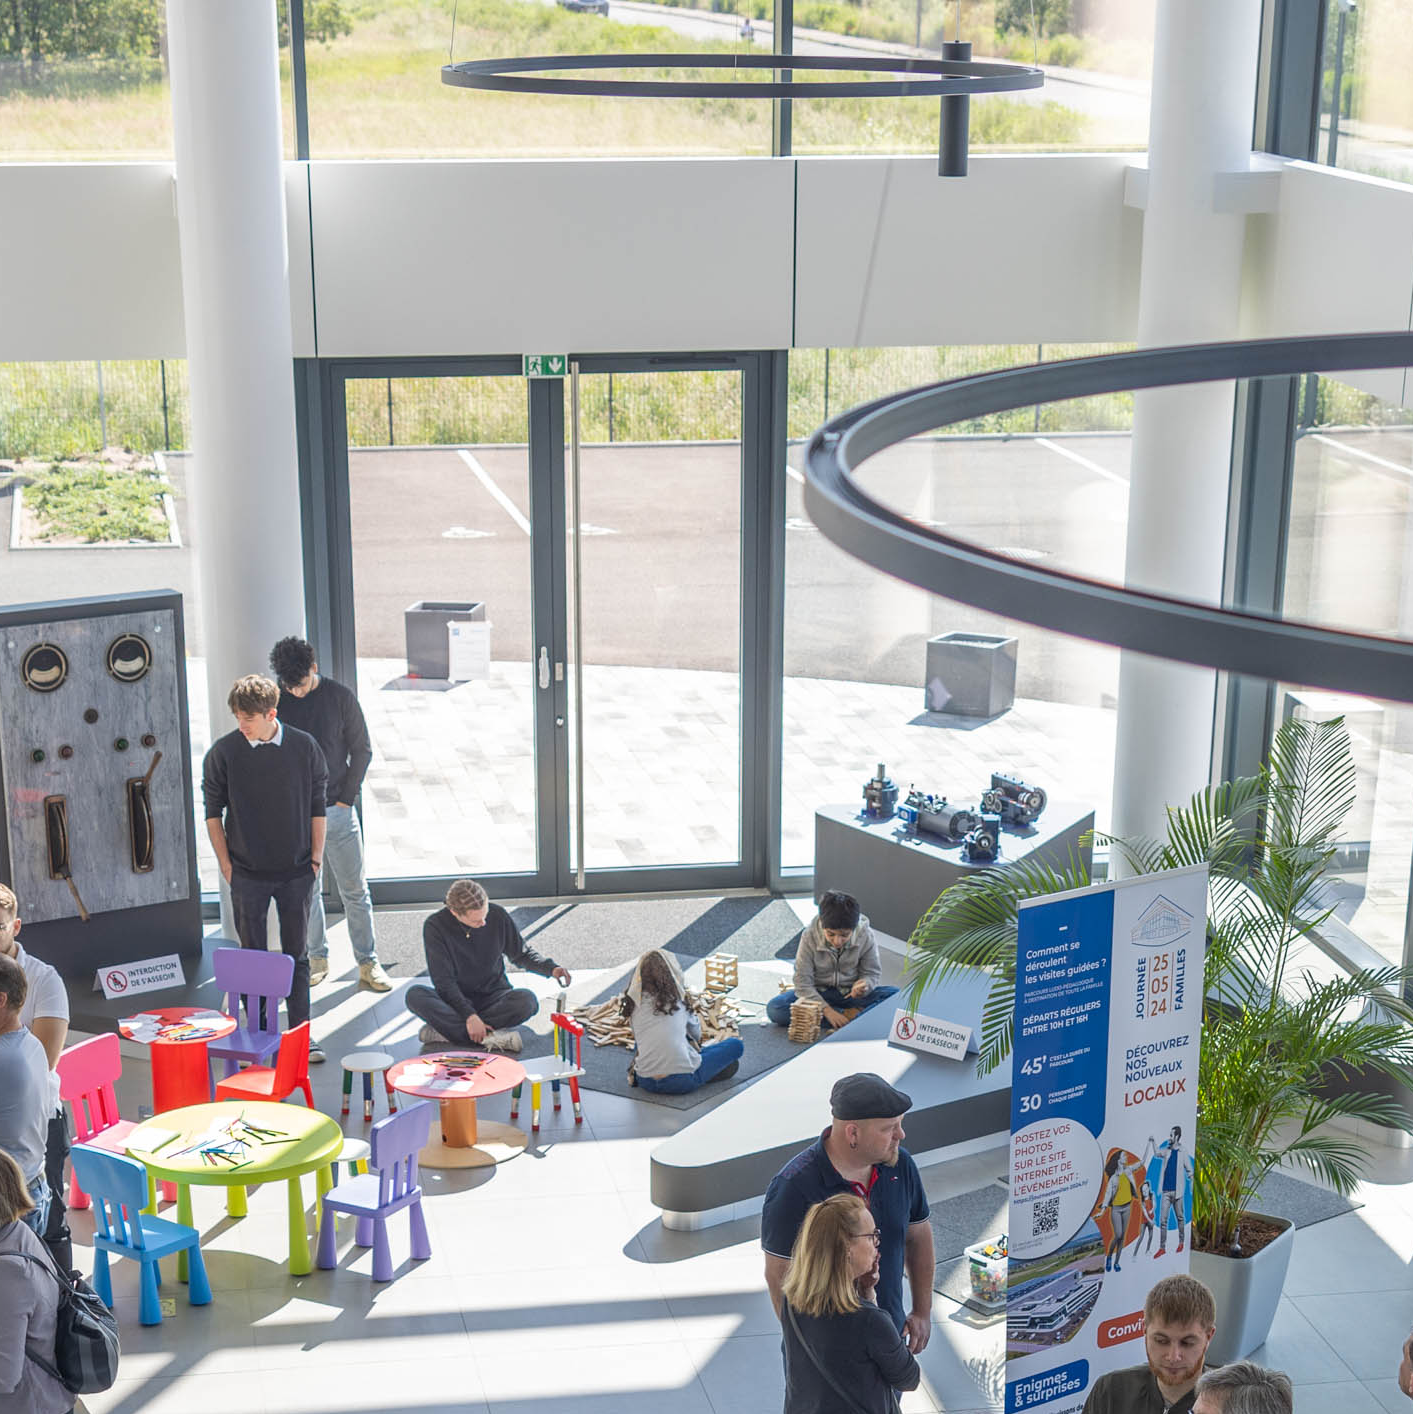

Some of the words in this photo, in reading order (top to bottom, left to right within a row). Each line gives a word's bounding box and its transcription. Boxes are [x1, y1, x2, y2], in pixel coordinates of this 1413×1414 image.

[1026, 943, 1068, 960] Comment
[1070, 942, 1081, 950] se
[128, 962, 177, 977] INTERDICTION
[1025, 975, 1037, 984] les
[1039, 969, 1066, 981] visites
[1067, 961, 1100, 977] guidées
[1101, 958, 1107, 967] ?
[1026, 956, 1067, 972] déroulent
[1153, 953, 1169, 972] 25
[131, 979, 139, 987] DE
[141, 972, 176, 985] S'ASSEOIR
[1136, 957, 1146, 1020] JOURNÉE
[1151, 976, 1169, 994] 05
[1175, 948, 1186, 1011] FAMILLES
[1023, 1010, 1059, 1026] DÉPARTS
[1060, 1000, 1101, 1017] RÉGULIERS
[1150, 998, 1167, 1017] 24
[919, 1023, 966, 1041] INTERDICTION
[1022, 1022, 1048, 1037] ENTRE
[1050, 1020, 1064, 1029] 10H
[1066, 1018, 1075, 1027] ET
[1076, 1014, 1089, 1024] 16H
[916, 1033, 925, 1041] DE
[926, 1036, 959, 1050] S'ASSEOIR
[1126, 1035, 1189, 1059] DÉCOUVREZ
[1125, 1060, 1183, 1084] NOUVEAUX
[1126, 1057, 1147, 1071] NOS
[1020, 1093, 1042, 1112] 30
[1124, 1078, 1187, 1107] LOCAUX
[1015, 1129, 1051, 1145] POSTEZ
[1053, 1124, 1071, 1136] VOS
[1015, 1141, 1053, 1158] PHOTOS
[1014, 1158, 1033, 1171] SUR
[1035, 1155, 1046, 1166] LE
[1048, 1150, 1066, 1162] SITE
[1014, 1165, 1058, 1184] INTERNET
[1060, 1161, 1072, 1172] DE
[1014, 1172, 1074, 1196] L'ÉVÉNEMENT
[1014, 1395, 1024, 1408] &
[1026, 1378, 1081, 1405] surprises
[1015, 1371, 1068, 1397] Enigmes
